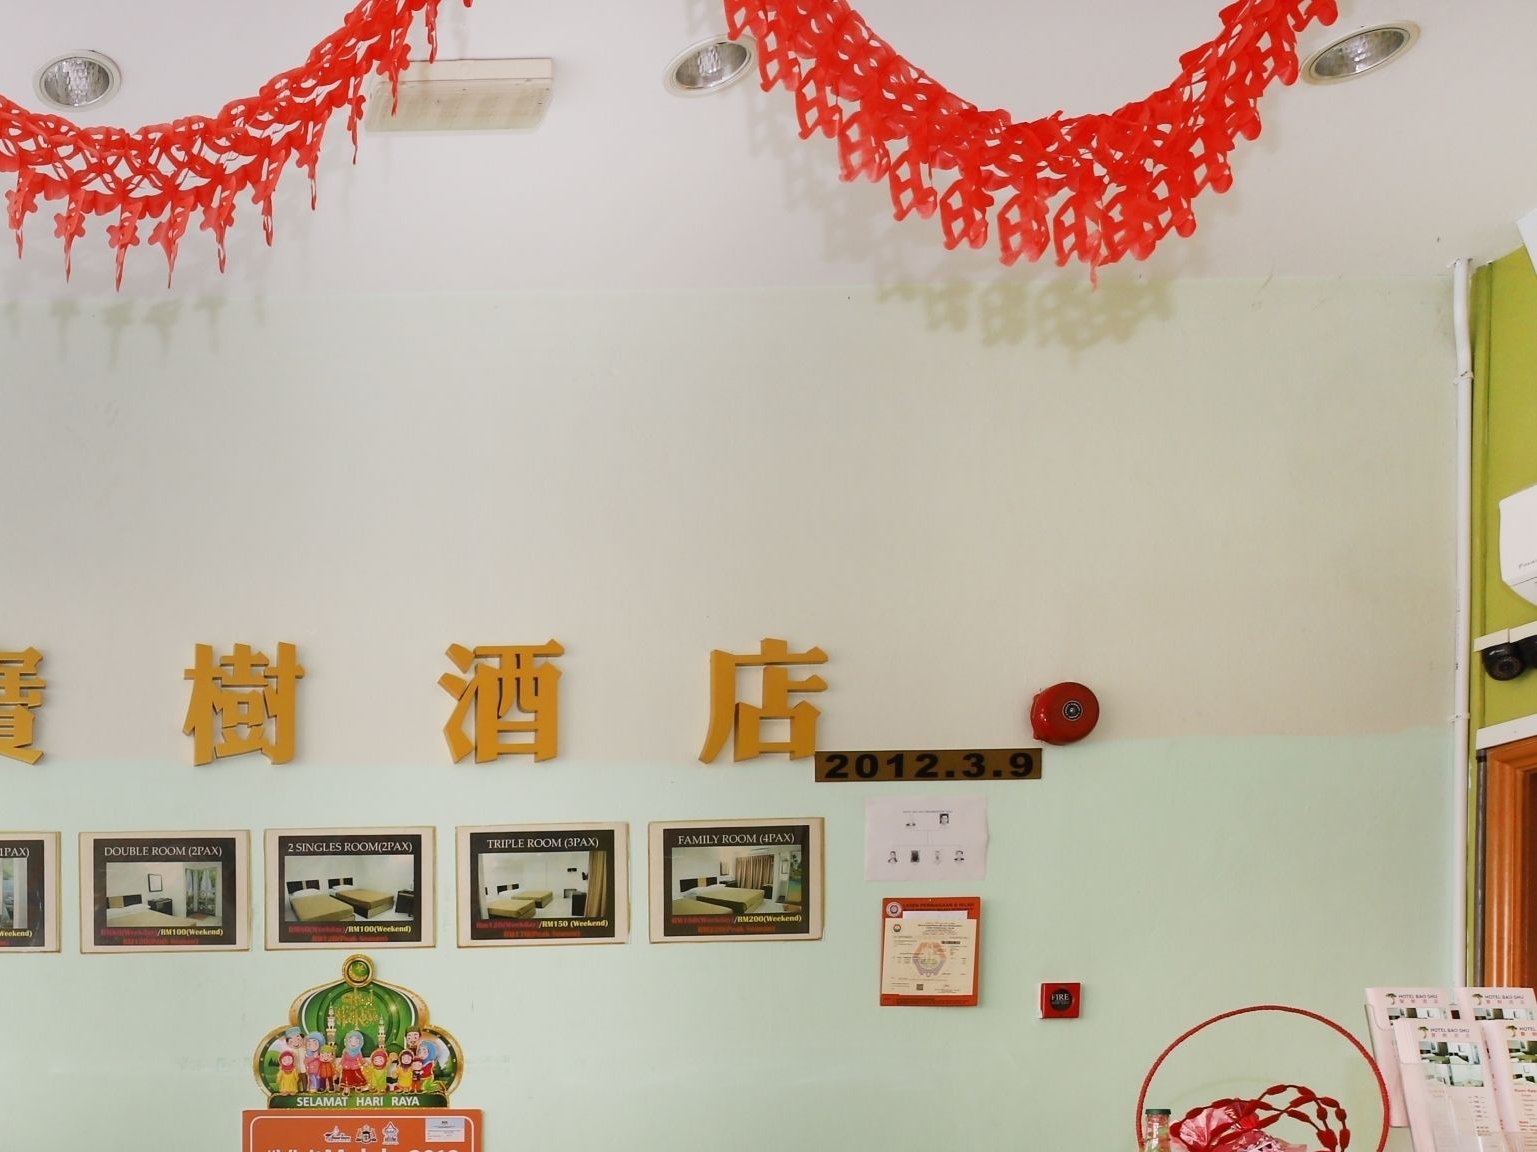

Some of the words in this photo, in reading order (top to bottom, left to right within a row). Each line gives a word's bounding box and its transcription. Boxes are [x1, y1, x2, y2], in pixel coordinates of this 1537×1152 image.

[823, 751, 1035, 780] 2012.3.9
[486, 838, 525, 849] TRIPLE
[527, 837, 562, 848] ROOM
[564, 836, 599, 849] (3PAX)
[678, 834, 720, 845] FAMILY
[722, 833, 757, 844] ROOM
[759, 832, 795, 845] (4PAX)
[103, 846, 150, 857] DOUBLE
[151, 846, 186, 856] ROOM
[188, 845, 223, 857] (2PAX)
[287, 843, 294, 852] 2
[295, 842, 342, 852] SINGLES
[1051, 993, 1070, 1001] FIRE
[296, 1095, 349, 1107] SELAMAT
[356, 1095, 384, 1107] HARI
[391, 1095, 420, 1107] RAYA
